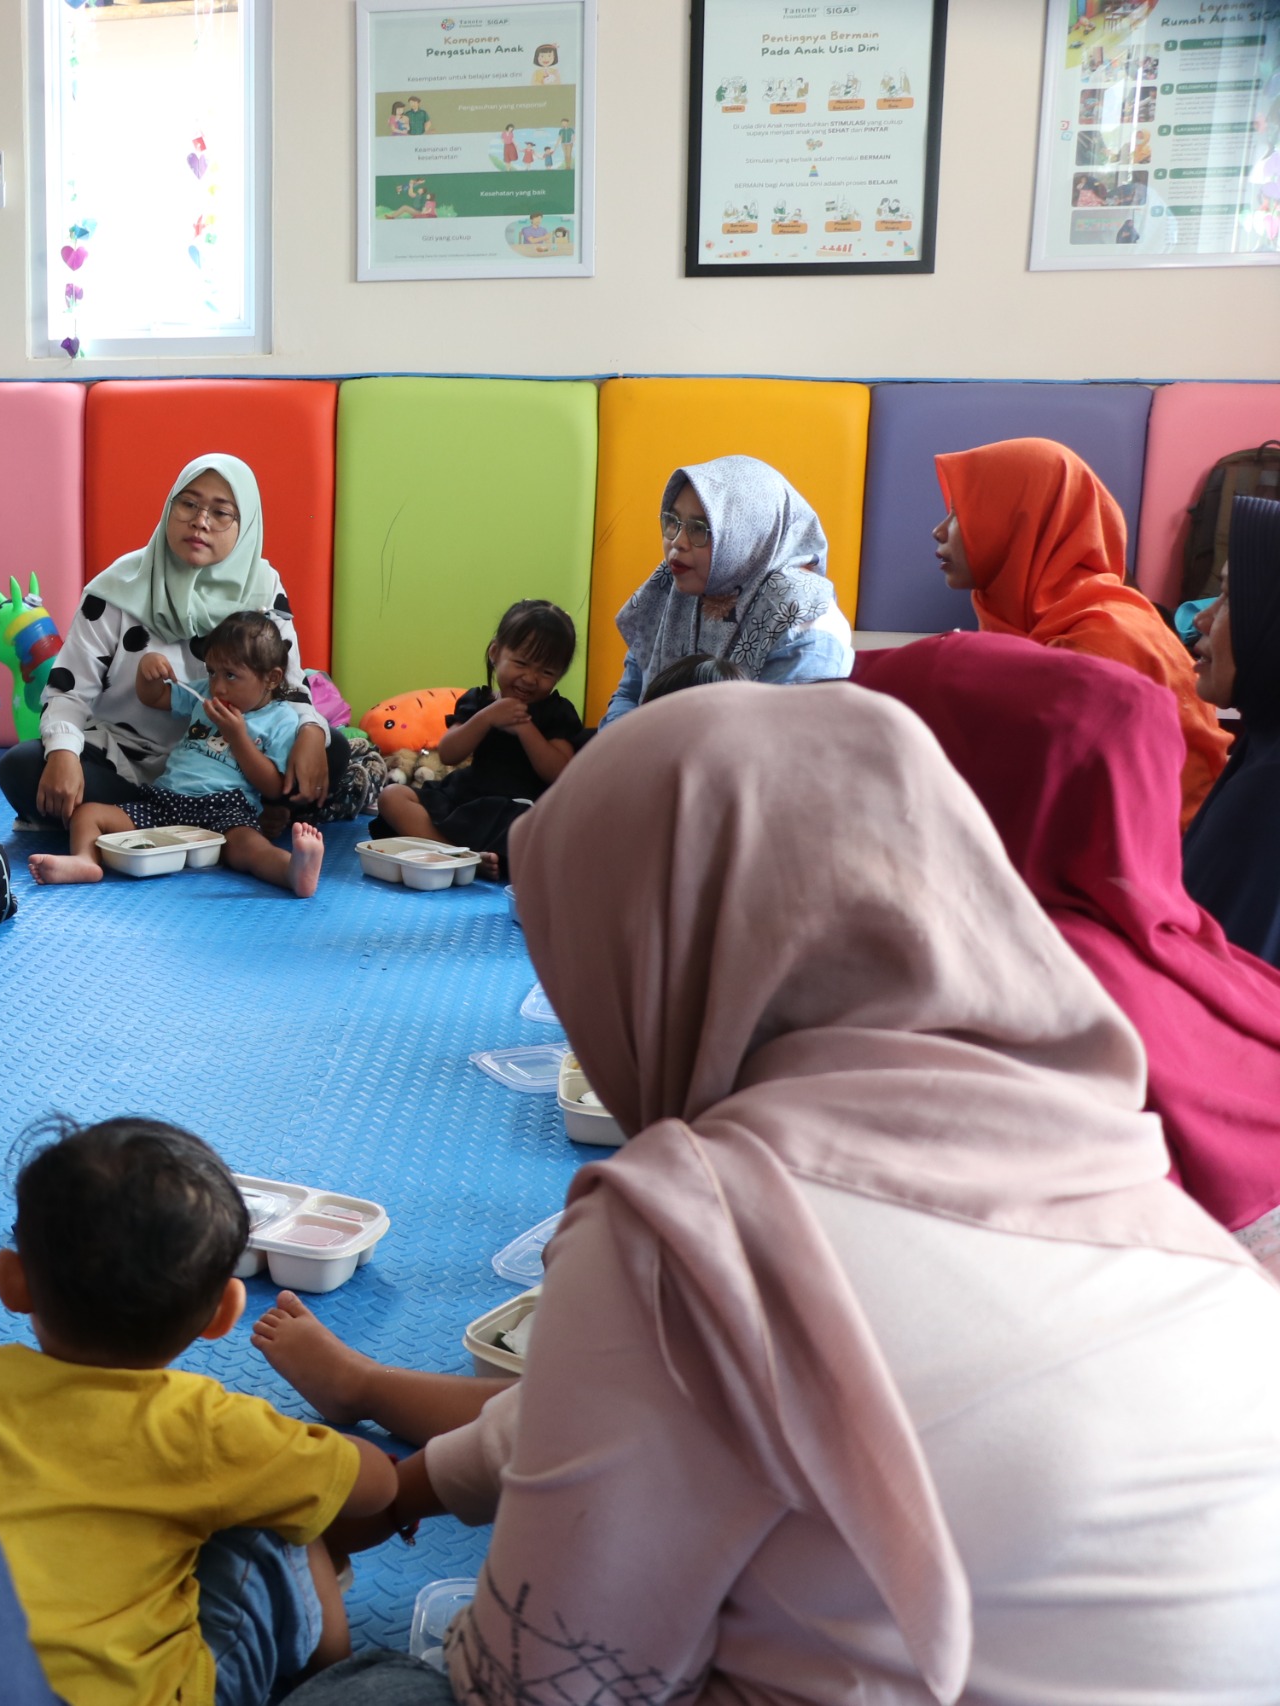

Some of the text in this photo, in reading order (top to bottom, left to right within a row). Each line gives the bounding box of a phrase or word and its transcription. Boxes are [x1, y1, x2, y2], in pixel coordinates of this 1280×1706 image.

[826, 7, 857, 15] SIGAP
[1161, 16, 1205, 27] Rumah
[444, 36, 500, 46] Komponen
[762, 31, 879, 44] Pentingnya Bermain
[426, 45, 524, 58] Pengasuhan Anak
[761, 44, 879, 56] Pada Anak Usia Dini
[468, 73, 491, 81] belajar
[492, 72, 508, 80] sejak
